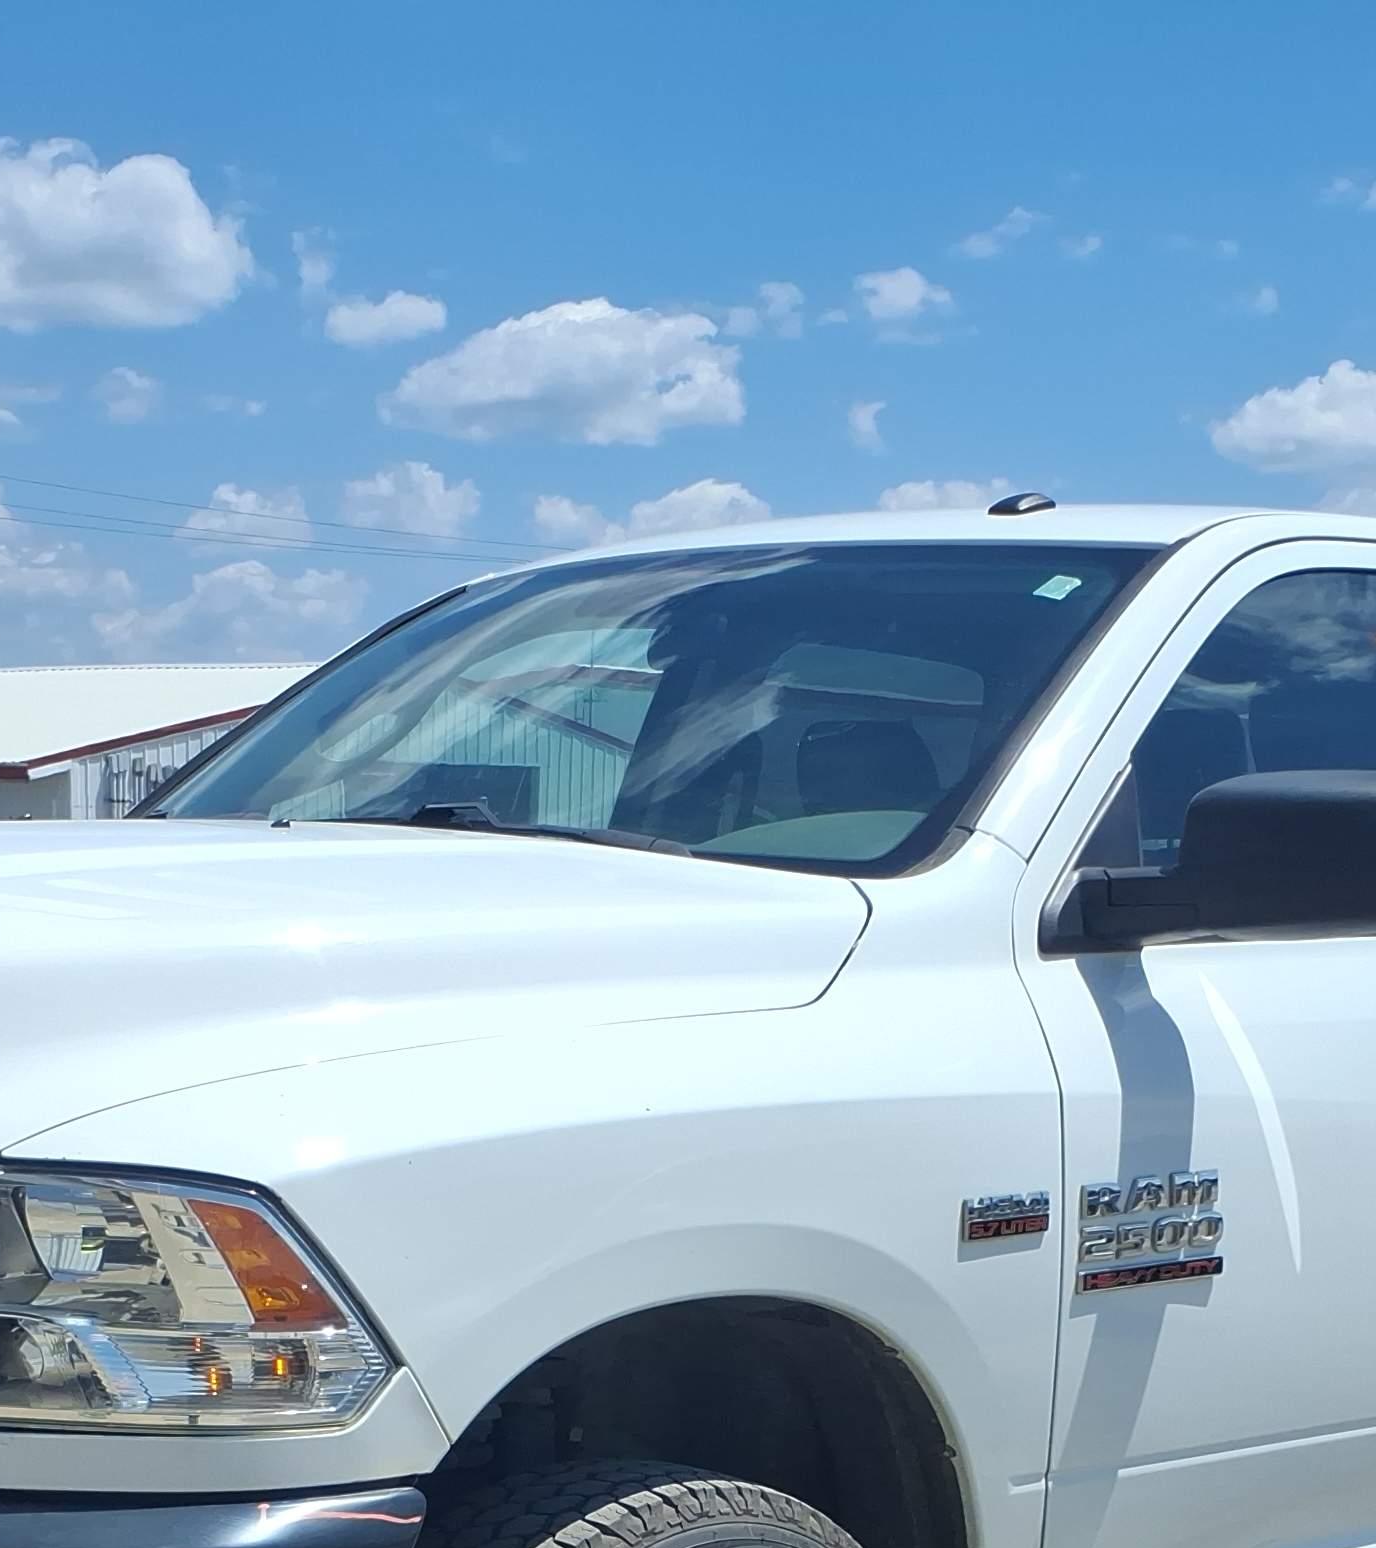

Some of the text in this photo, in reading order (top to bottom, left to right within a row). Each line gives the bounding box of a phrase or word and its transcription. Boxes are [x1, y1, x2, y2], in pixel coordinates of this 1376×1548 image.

[1080, 1169, 1218, 1220] RAM
[1000, 1216, 1047, 1235] LITER
[1079, 1209, 1224, 1263] 2500
[1085, 1260, 1220, 1290] HEAVY DUTY
